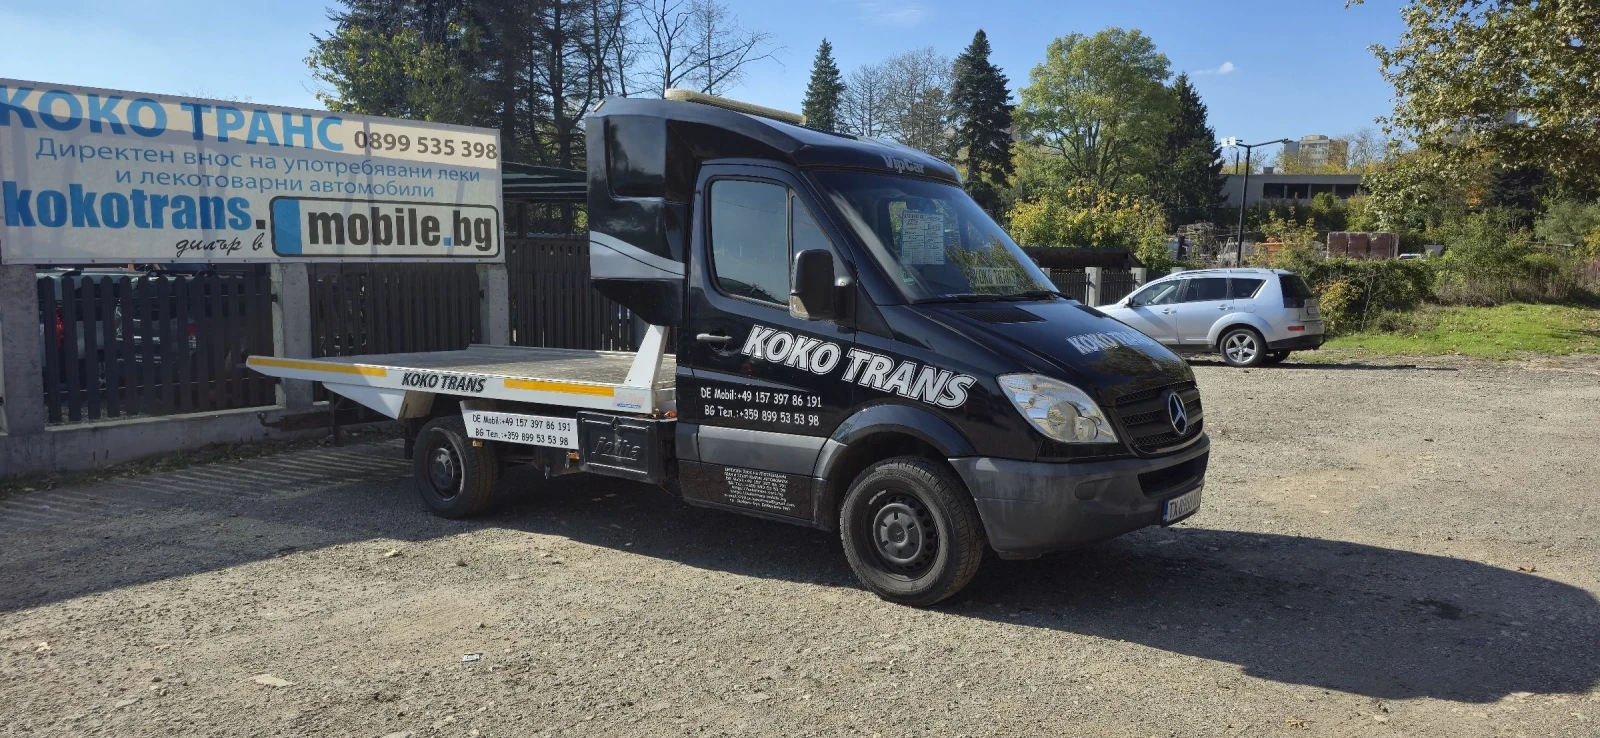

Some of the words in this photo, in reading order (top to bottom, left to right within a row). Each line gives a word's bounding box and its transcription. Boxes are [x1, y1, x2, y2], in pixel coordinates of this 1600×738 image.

[180, 101, 344, 151] ТРАНС
[354, 130, 411, 151] 0899
[417, 136, 455, 156] 535
[461, 140, 498, 160] 398
[35, 138, 175, 164] Директен
[184, 151, 242, 168] внос
[250, 155, 277, 170] на
[283, 158, 432, 180] употребявани
[437, 168, 480, 182] леки
[882, 155, 925, 174] VipCar
[115, 170, 131, 184] и
[139, 171, 303, 193] лекотоварни
[309, 179, 435, 198] автомобили
[307, 206, 492, 252] mobile.bg
[175, 236, 242, 258] дилър
[741, 324, 841, 375] KOKO
[841, 347, 977, 409] TRANS
[401, 372, 440, 389] KOKO
[440, 376, 487, 394] TRANS
[701, 387, 711, 399] DE
[755, 391, 771, 404] 157
[773, 393, 789, 405] 397
[792, 394, 803, 407] 86
[807, 396, 822, 408] 191
[472, 413, 481, 423] DE
[516, 418, 528, 428] 157
[530, 419, 543, 429] 397
[546, 420, 555, 430] 86
[558, 422, 571, 432] 191
[704, 404, 715, 416] BG
[761, 410, 777, 422] 899
[780, 411, 791, 424] 53
[794, 413, 805, 425] 53
[808, 414, 820, 427] 98
[475, 427, 484, 437] BG
[521, 432, 534, 442] 899
[536, 433, 545, 443] 53
[547, 435, 556, 445] 53
[559, 436, 569, 446] 98
